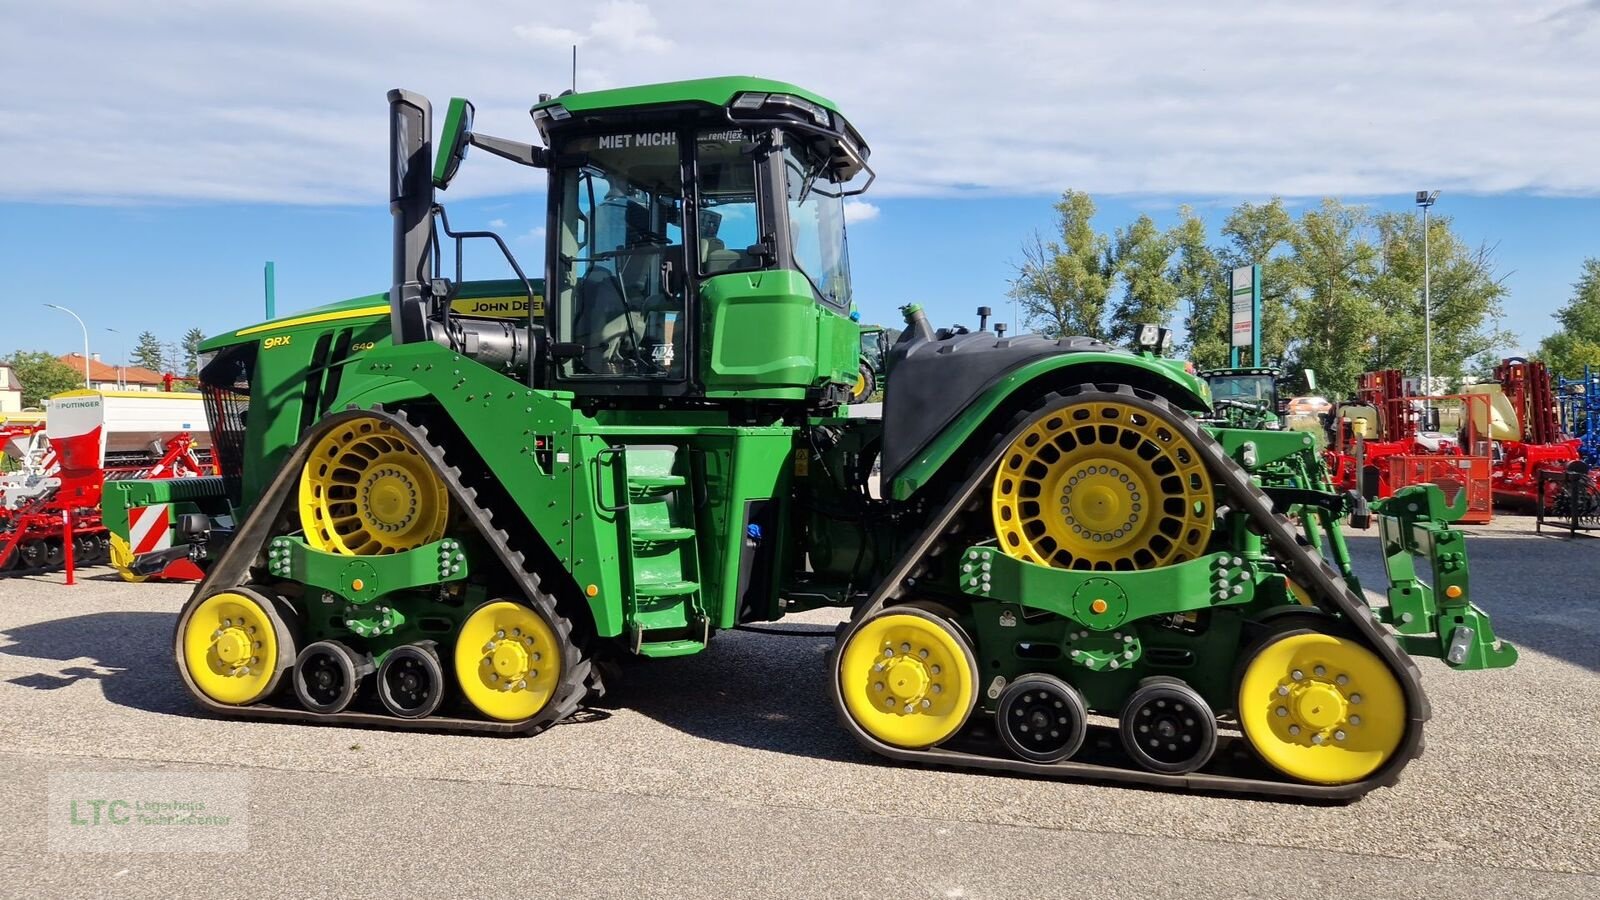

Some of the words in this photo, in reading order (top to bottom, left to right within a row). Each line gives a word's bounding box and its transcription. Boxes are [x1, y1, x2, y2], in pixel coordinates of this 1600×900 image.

[599, 134, 632, 149] MIET
[635, 132, 676, 147] MICH!
[472, 302, 509, 312] JOHN
[512, 301, 545, 311] DEE
[264, 335, 291, 349] 9RX
[352, 342, 374, 351] 640
